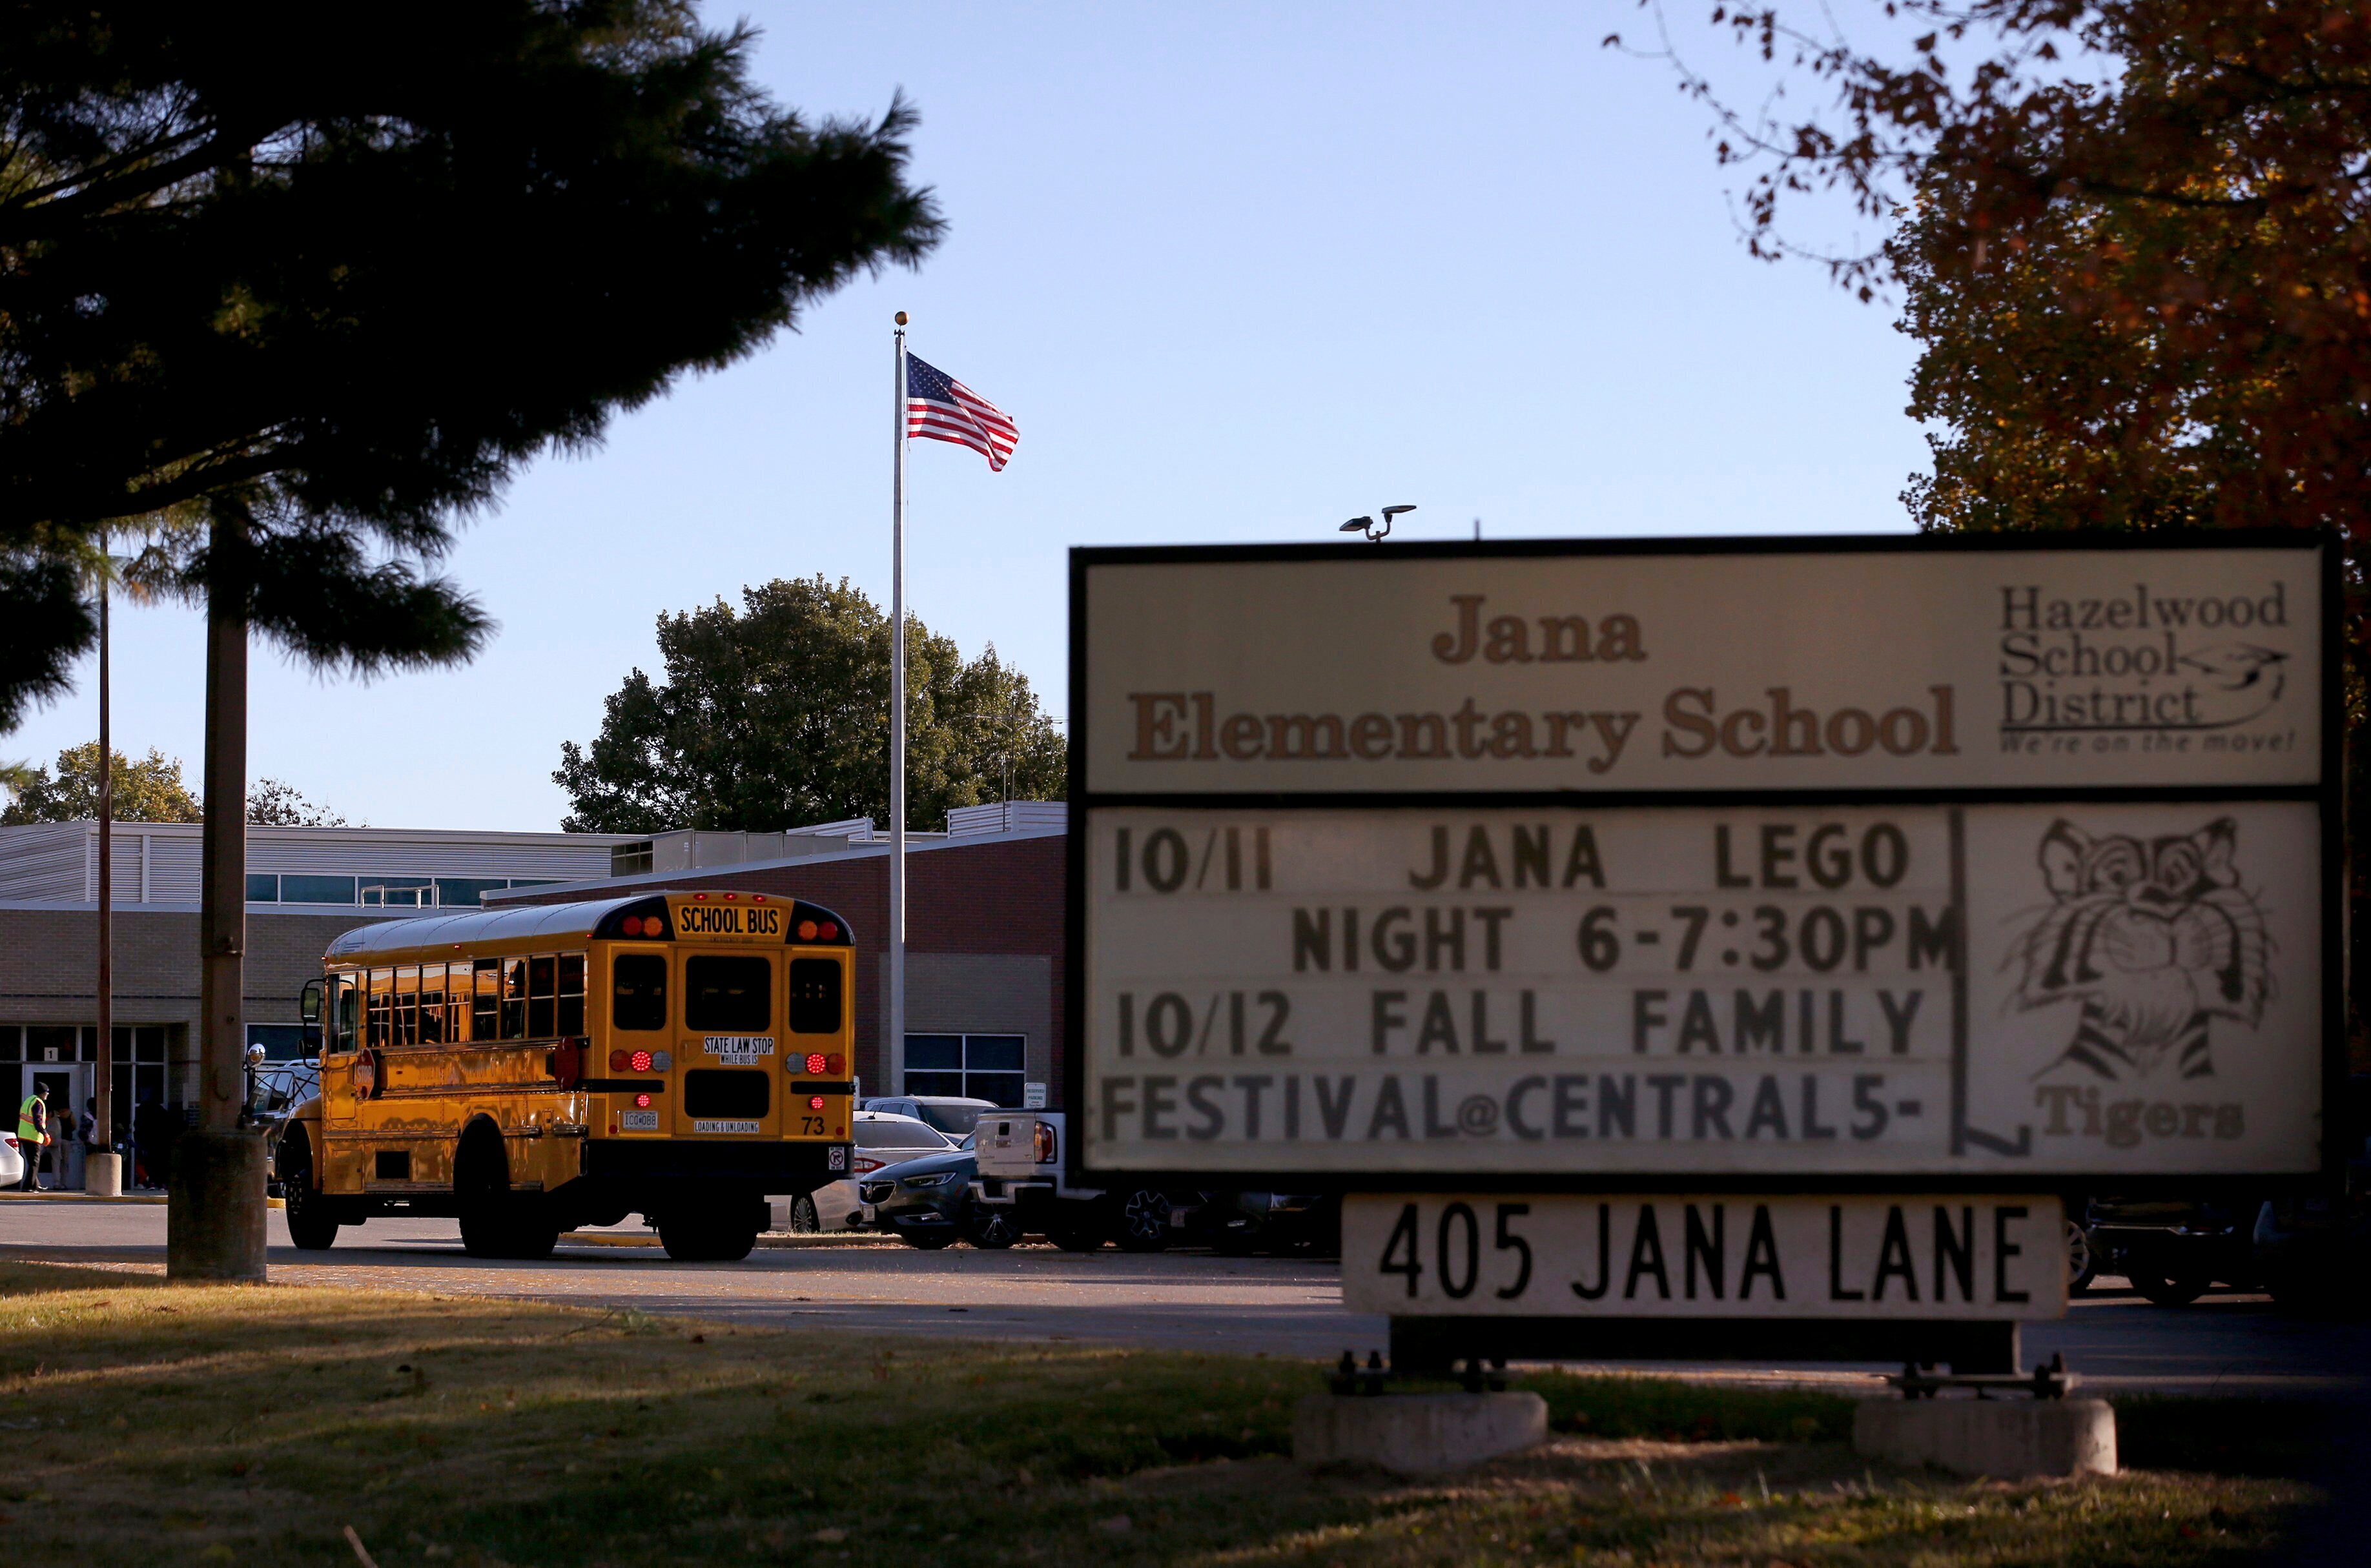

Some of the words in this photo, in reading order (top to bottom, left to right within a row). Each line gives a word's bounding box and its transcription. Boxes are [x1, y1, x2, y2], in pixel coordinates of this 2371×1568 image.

[1432, 595, 1648, 664] Jana
[2000, 582, 2286, 630] Hazelwood
[2000, 631, 2179, 678] School
[2001, 677, 2201, 726] District
[1127, 691, 1641, 775] Elementary
[1662, 684, 1959, 759] School
[2002, 731, 2080, 753] We're
[2092, 735, 2129, 752] on
[2142, 731, 2189, 752] the
[2202, 729, 2297, 752] move!
[1116, 826, 1272, 893] 10/11
[1408, 824, 1606, 890] JANA
[1714, 822, 1909, 890] LEGO
[681, 907, 743, 933] SCHOOL
[747, 908, 778, 934] BUS
[1293, 906, 1514, 973] NIGHT
[1577, 906, 1954, 973] 6-7:30PM
[704, 1037, 728, 1053] STATE
[732, 1037, 750, 1054] LAW
[752, 1038, 773, 1054] STOP
[1118, 990, 1292, 1058] 10/12
[1372, 988, 1555, 1056] FALL
[1632, 988, 1924, 1056] FAMILY
[48, 1050, 52, 1059] 1
[357, 1065, 373, 1083] STOP
[721, 1054, 738, 1064] WHILE
[739, 1055, 750, 1064] BUS
[752, 1055, 757, 1064] IS
[695, 1121, 719, 1132] LOADING
[721, 1122, 724, 1132] &
[726, 1122, 758, 1132] UNLOADING
[801, 1116, 825, 1135] 73
[2035, 1084, 2245, 1150] Tigers
[1379, 1201, 1533, 1300] 405
[1571, 1203, 1787, 1301] JANA
[1829, 1205, 2031, 1303] LANE
